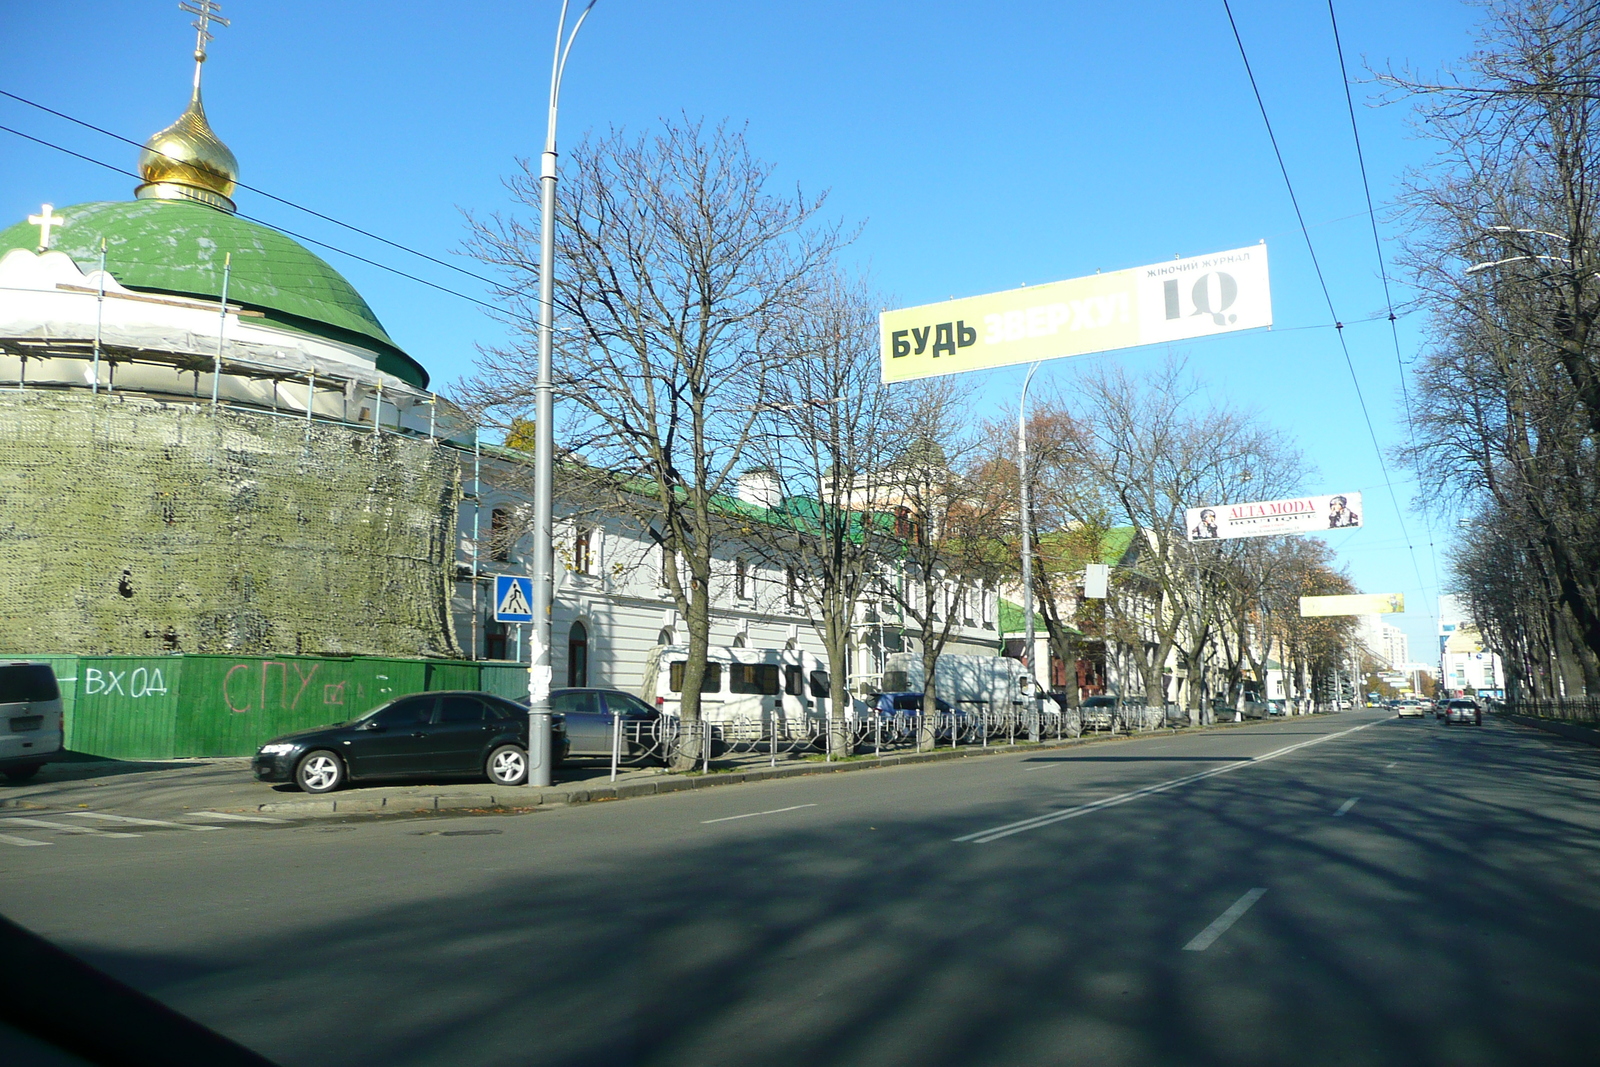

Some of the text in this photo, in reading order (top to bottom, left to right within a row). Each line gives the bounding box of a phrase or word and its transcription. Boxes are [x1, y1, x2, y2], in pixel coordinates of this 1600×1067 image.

[1147, 253, 1251, 278] ЖІНОЧИЙ ЖУРНАЛ
[891, 292, 1130, 359] БУДЬ ЗВЕРХУ!
[1229, 500, 1316, 518] ALTA MODA
[85, 667, 167, 698] ВХОД
[223, 661, 319, 714] СПУ
